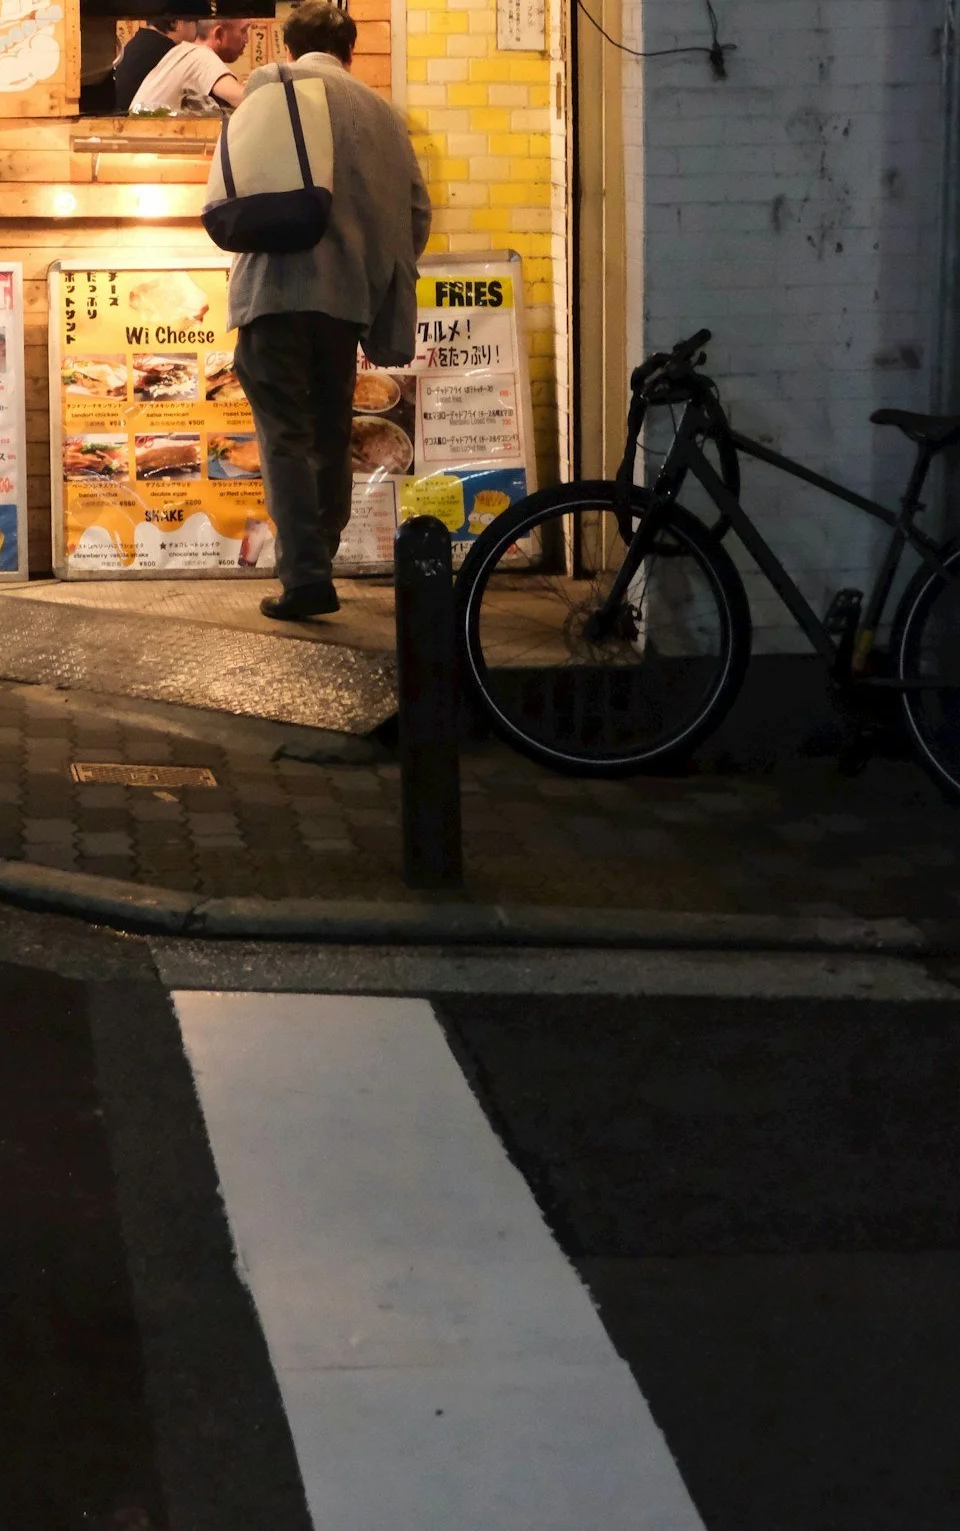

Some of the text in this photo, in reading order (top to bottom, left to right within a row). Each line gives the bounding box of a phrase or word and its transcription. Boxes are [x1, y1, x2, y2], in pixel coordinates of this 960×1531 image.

[108, 272, 119, 307] チーズ
[435, 280, 503, 308] FRIES
[65, 272, 76, 345] ホットサンド
[125, 326, 215, 345] Wi Cheese
[145, 509, 184, 523] SHAKE
